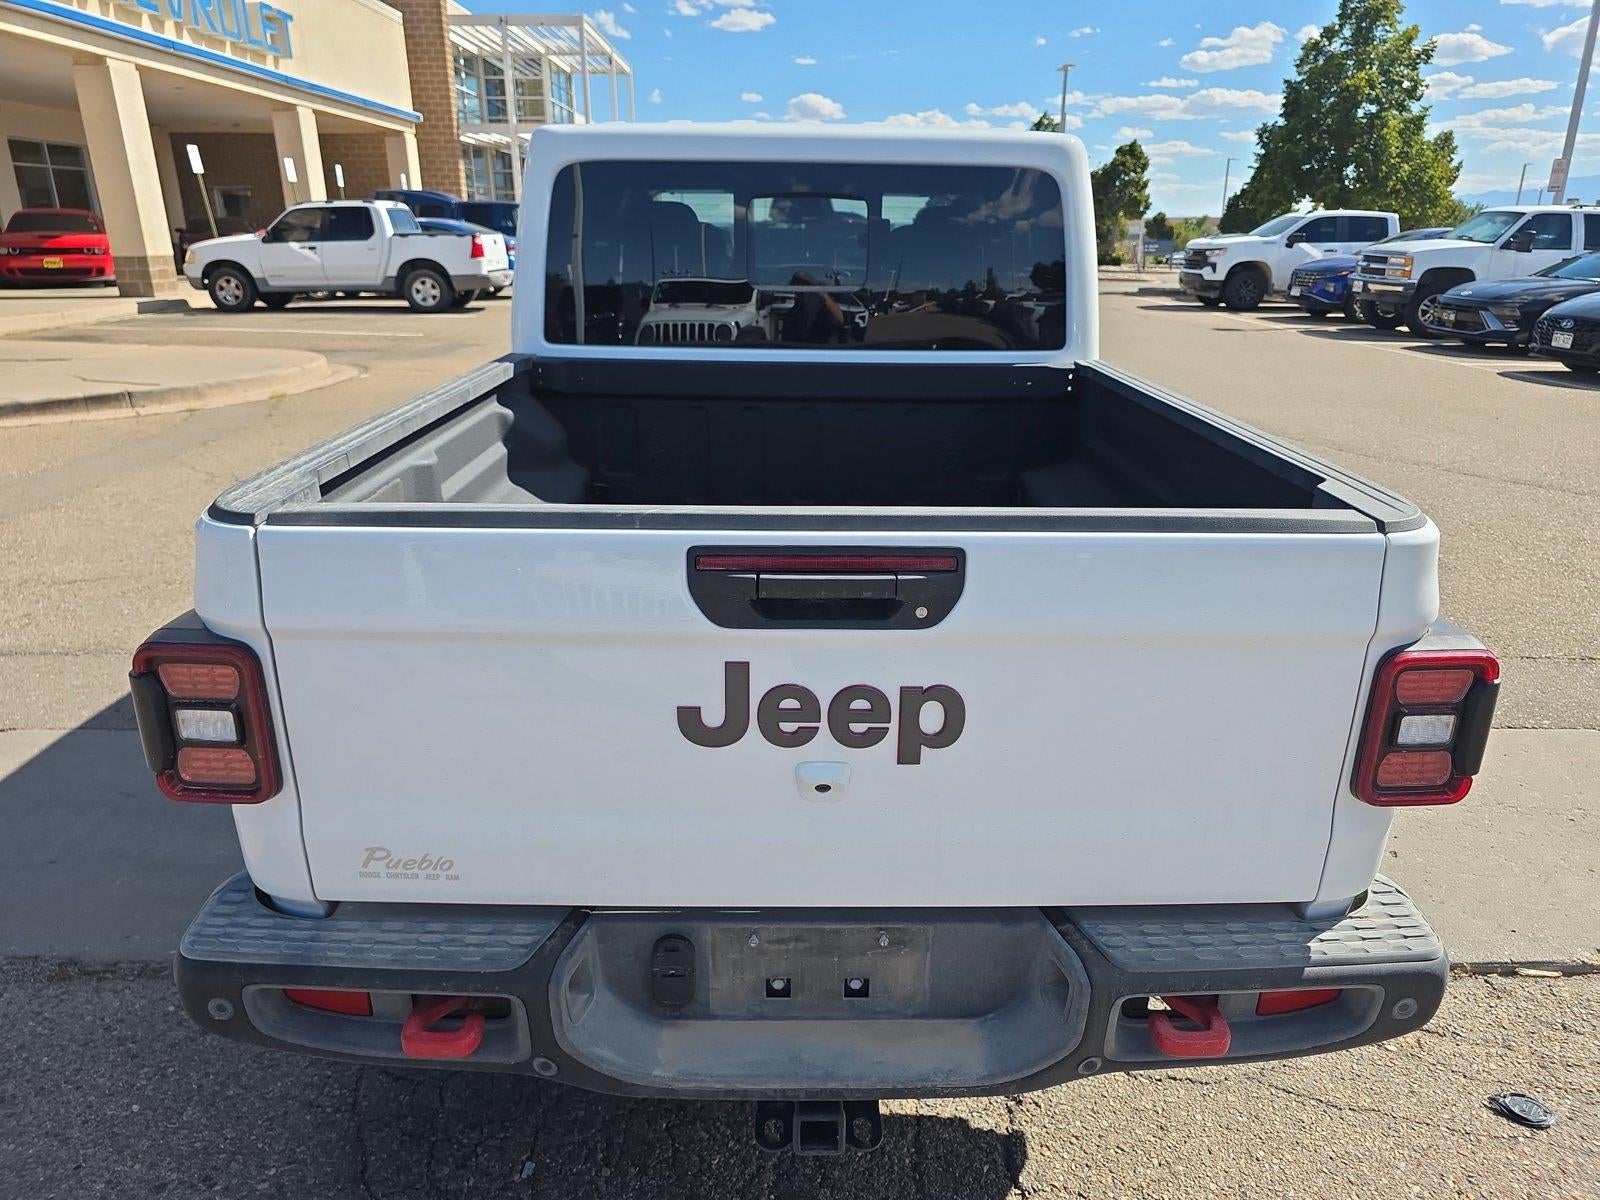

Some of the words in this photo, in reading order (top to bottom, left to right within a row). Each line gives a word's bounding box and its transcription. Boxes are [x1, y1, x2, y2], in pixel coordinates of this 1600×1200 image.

[677, 661, 966, 765] Jeep
[361, 846, 454, 871] Pueblo
[425, 873, 440, 881] JEEP
